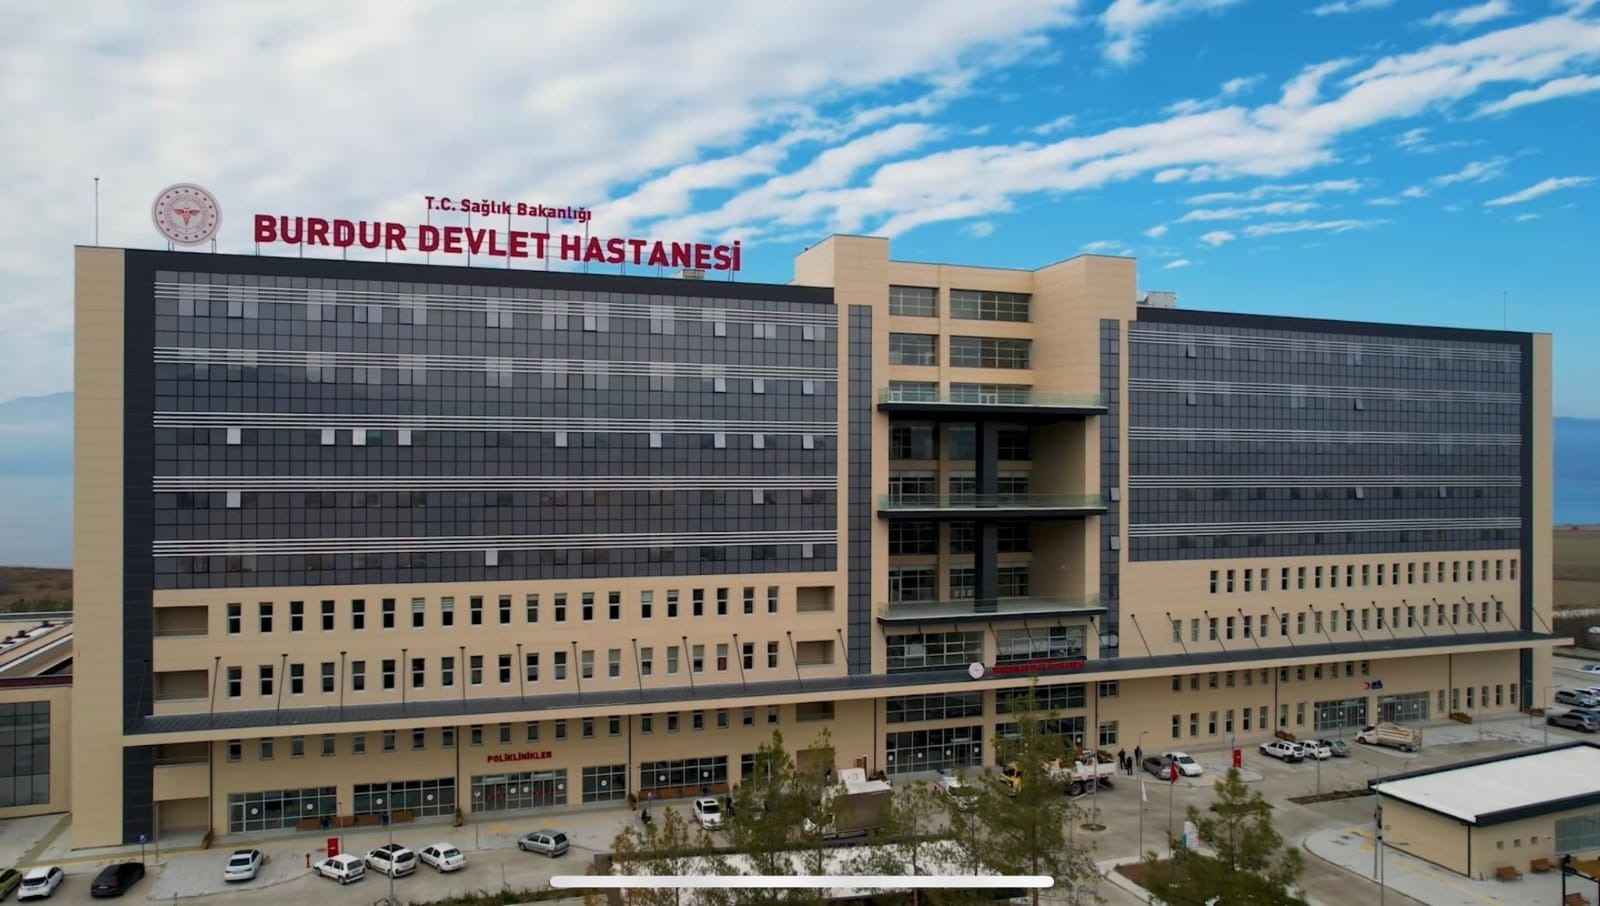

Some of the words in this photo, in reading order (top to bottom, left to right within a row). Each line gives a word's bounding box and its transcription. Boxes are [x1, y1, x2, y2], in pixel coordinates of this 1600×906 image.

[425, 196, 456, 211] T.C.
[461, 199, 511, 217] Sağlık
[518, 203, 592, 223] Bakanlığı
[254, 215, 406, 251] BURDUR
[419, 225, 551, 259] DEVLET
[561, 235, 741, 270] HASTANESİ
[488, 751, 552, 763] POLİKLİNİKLER
